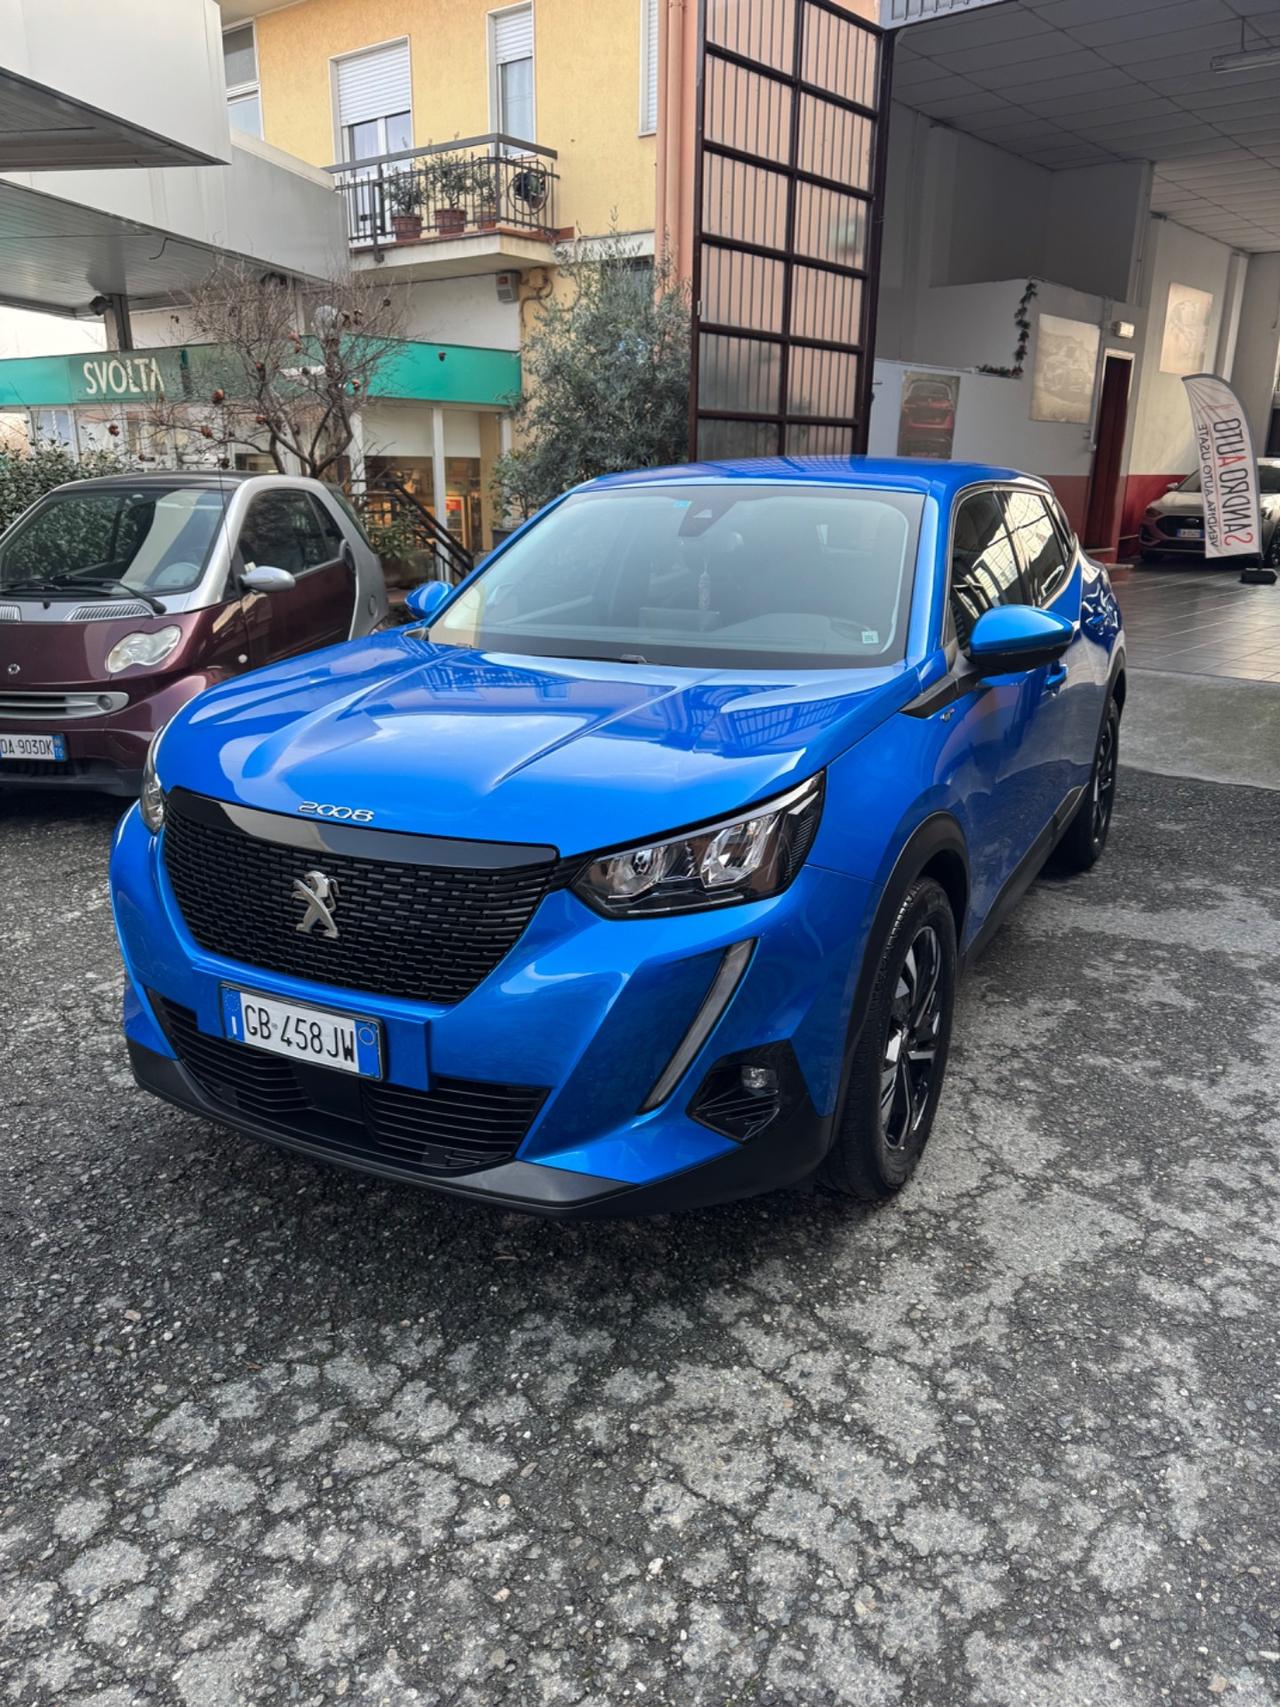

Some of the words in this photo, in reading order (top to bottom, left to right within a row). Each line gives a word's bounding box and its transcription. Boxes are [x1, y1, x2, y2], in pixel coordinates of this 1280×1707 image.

[83, 357, 165, 395] SVOLTA
[299, 801, 375, 822] 2008
[244, 1004, 272, 1040] GB
[280, 1015, 355, 1063] 458JW
